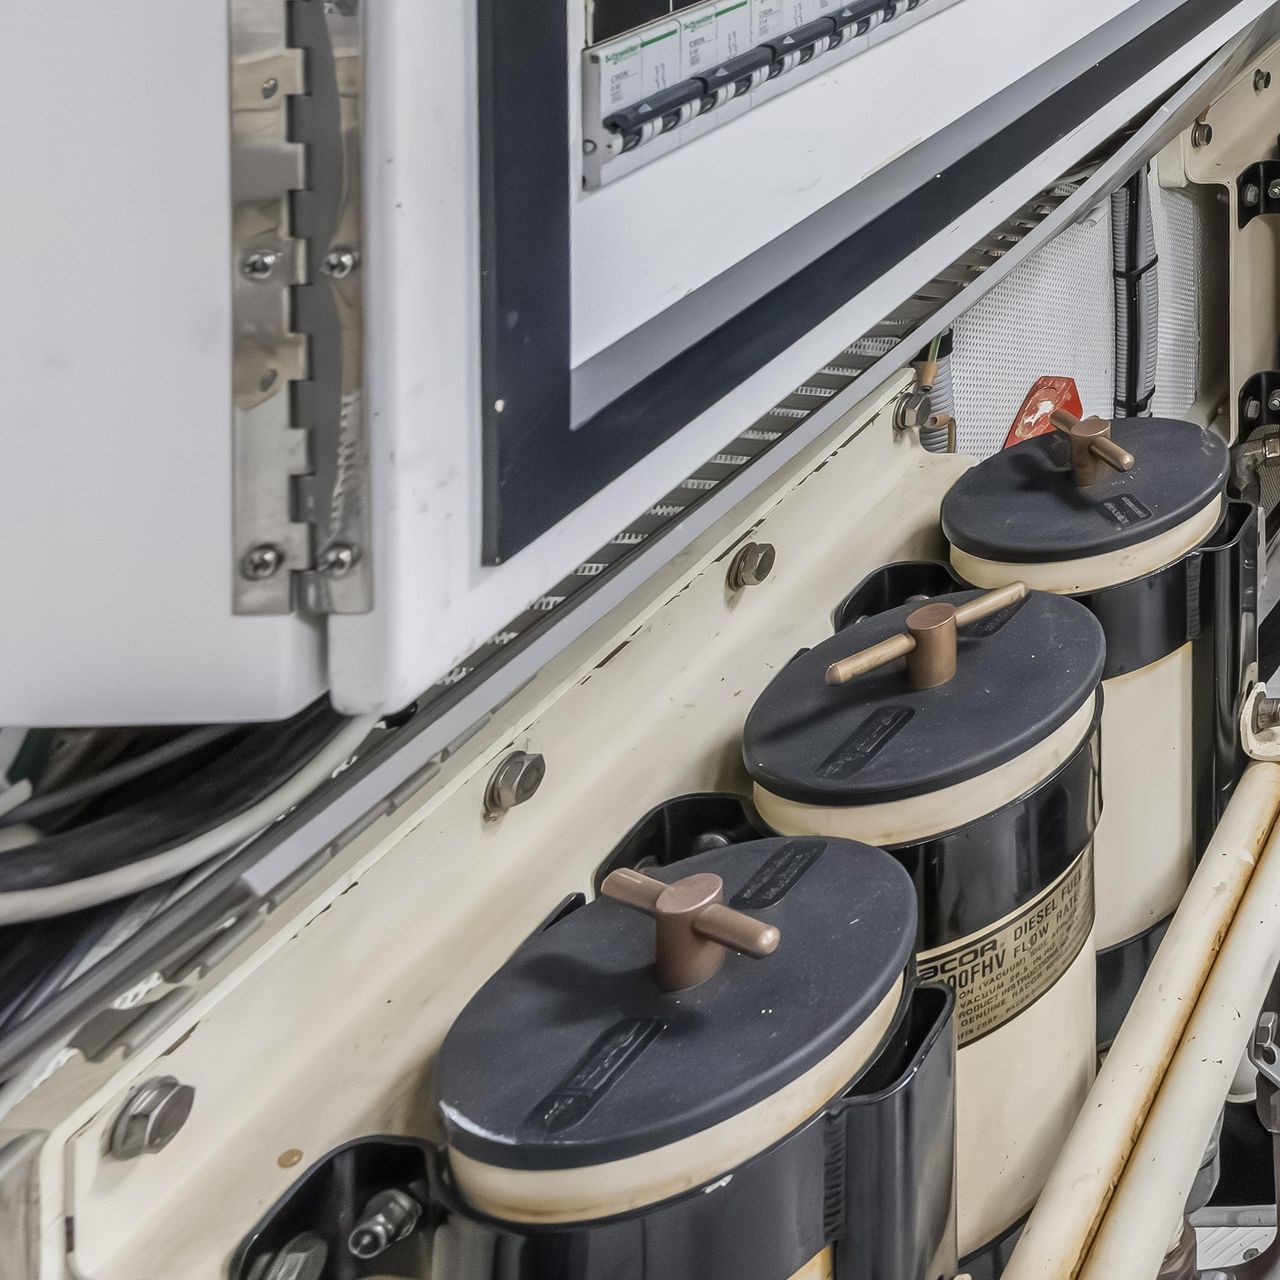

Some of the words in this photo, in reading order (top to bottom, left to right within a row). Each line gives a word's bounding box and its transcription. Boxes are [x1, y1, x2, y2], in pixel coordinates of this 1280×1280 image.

[917, 939, 997, 981] ACOR
[1013, 899, 1058, 941] DIESEL
[1061, 869, 1082, 901] FUEL
[1013, 922, 1049, 958] FLOW
[1056, 890, 1080, 923] RATE
[960, 980, 1004, 1009] VACUUM
[961, 999, 1007, 1027] GENUINE
